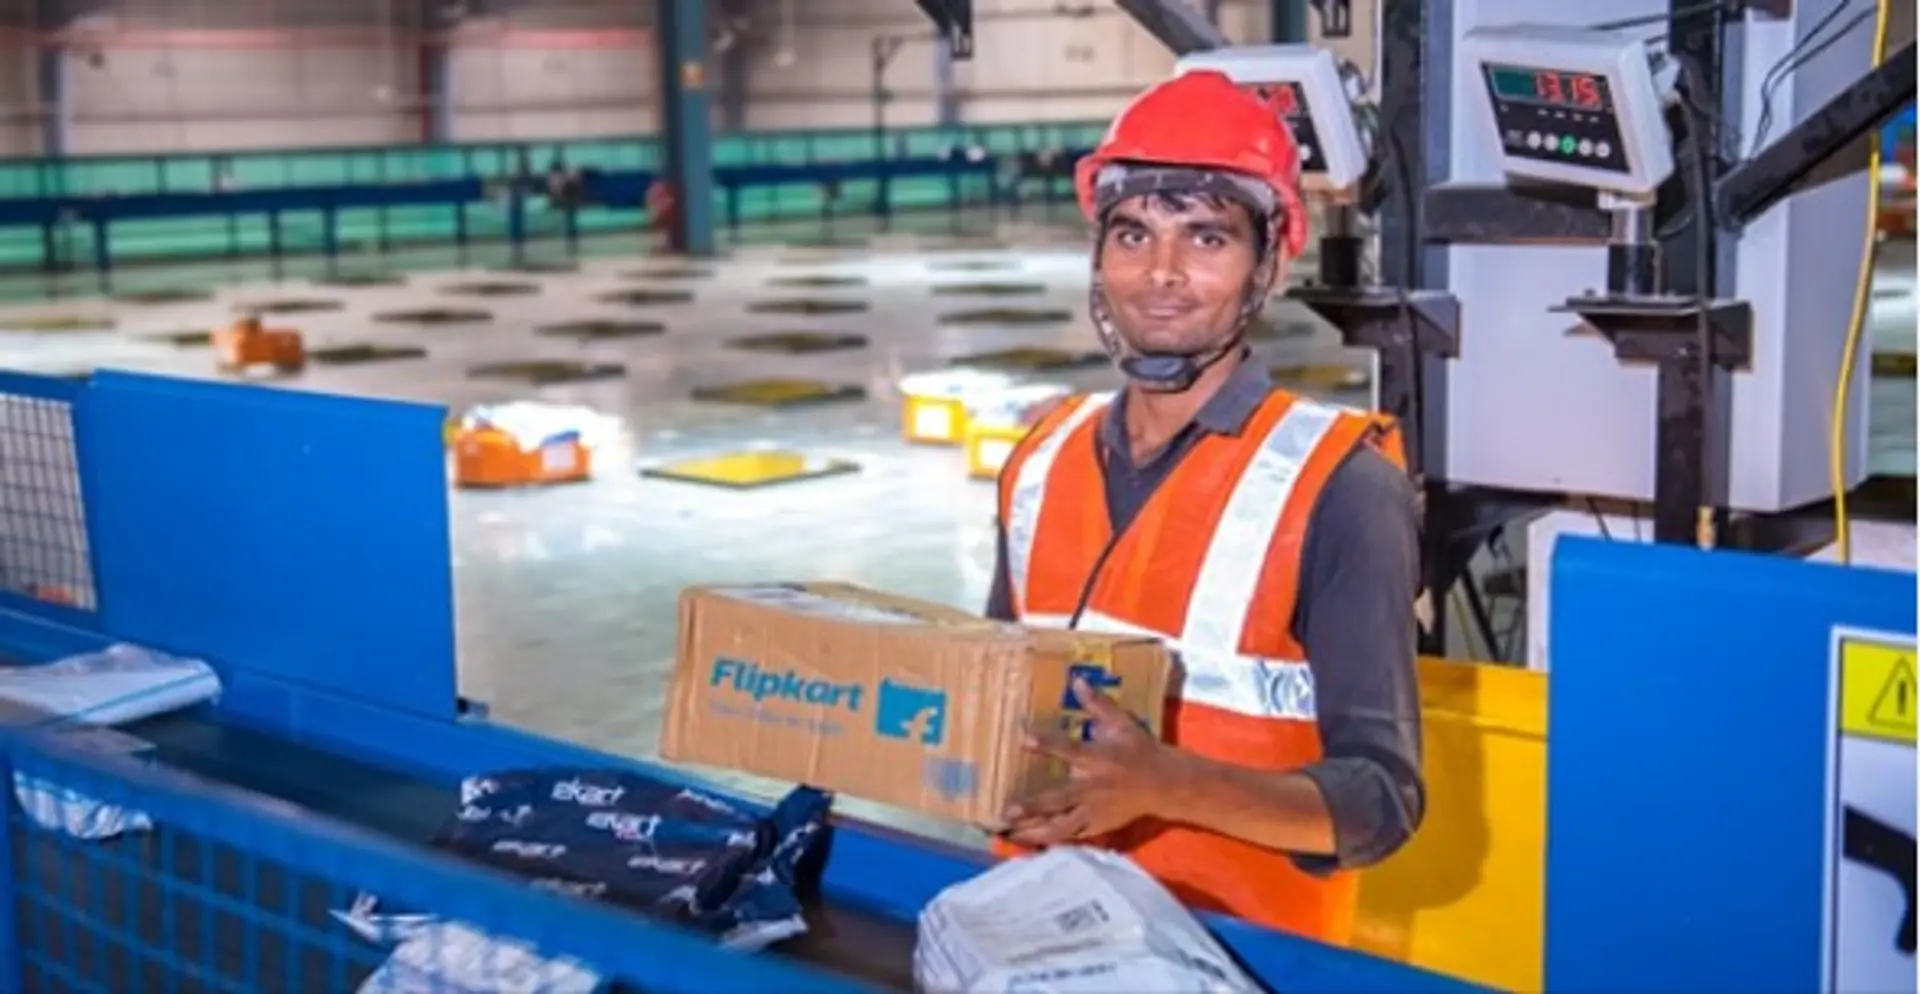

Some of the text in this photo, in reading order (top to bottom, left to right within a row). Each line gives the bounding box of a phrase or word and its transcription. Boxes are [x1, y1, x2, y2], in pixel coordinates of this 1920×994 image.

[710, 657, 865, 713] Flipkart
[552, 779, 625, 805] ekart
[586, 811, 662, 836] ekart
